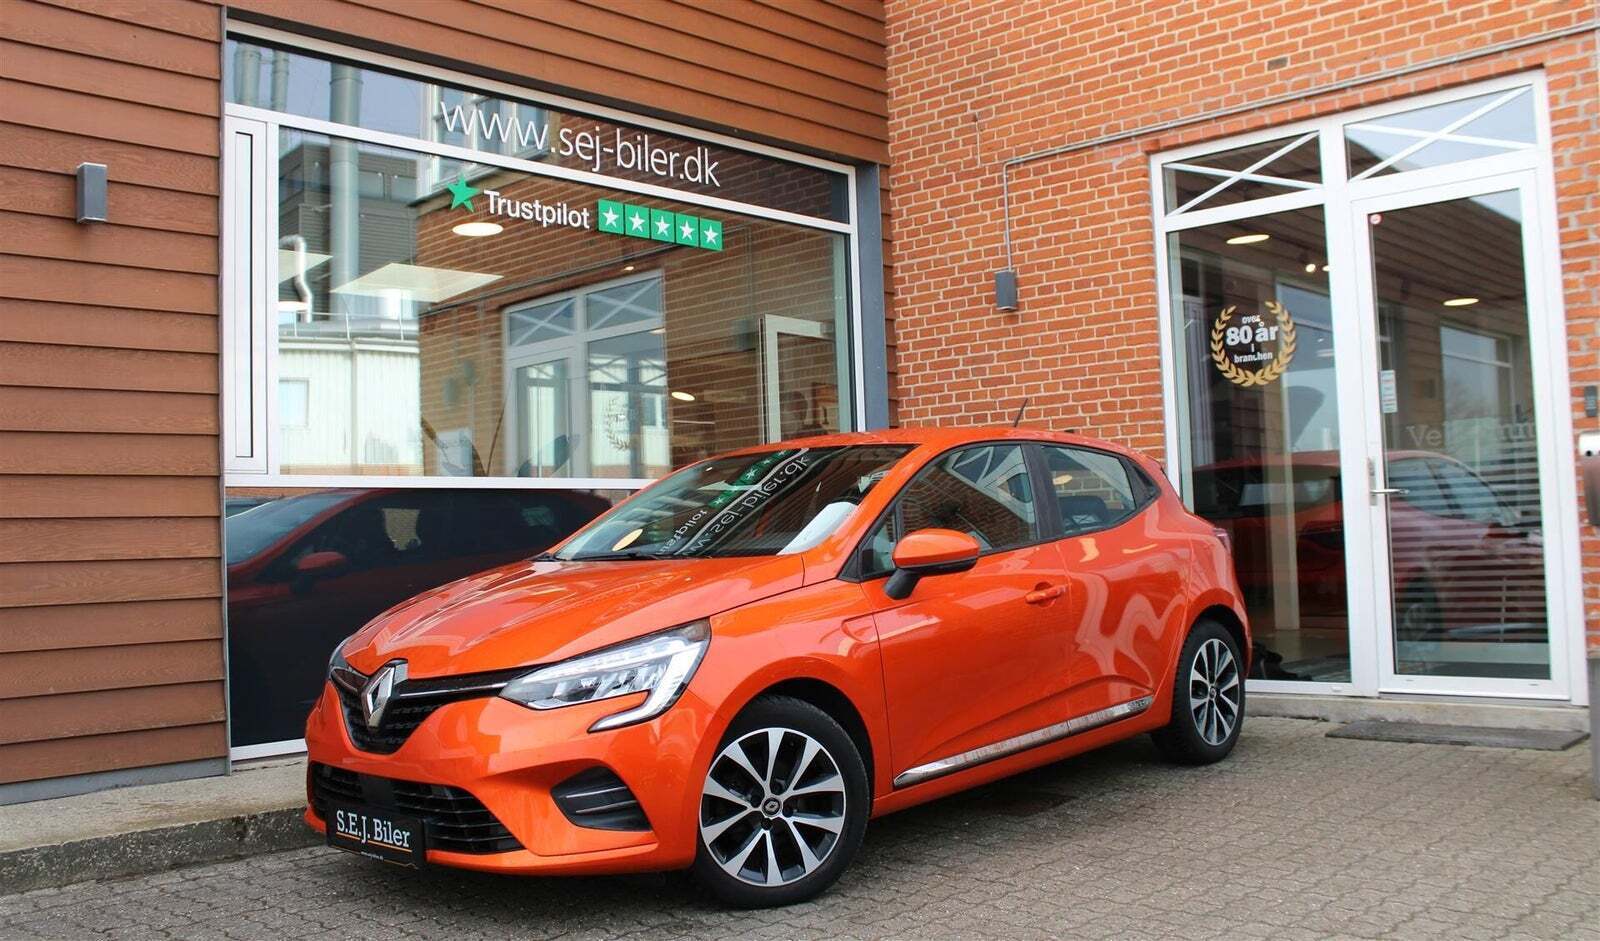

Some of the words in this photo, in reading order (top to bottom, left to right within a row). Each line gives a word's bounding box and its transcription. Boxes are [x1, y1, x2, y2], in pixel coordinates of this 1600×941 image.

[440, 101, 721, 187] www.sej-biler.dk
[484, 190, 590, 229] Trustpilot
[1226, 325, 1253, 346] 80
[1255, 321, 1279, 342] år
[336, 810, 370, 843] S.E.J.
[373, 818, 410, 848] Biler
